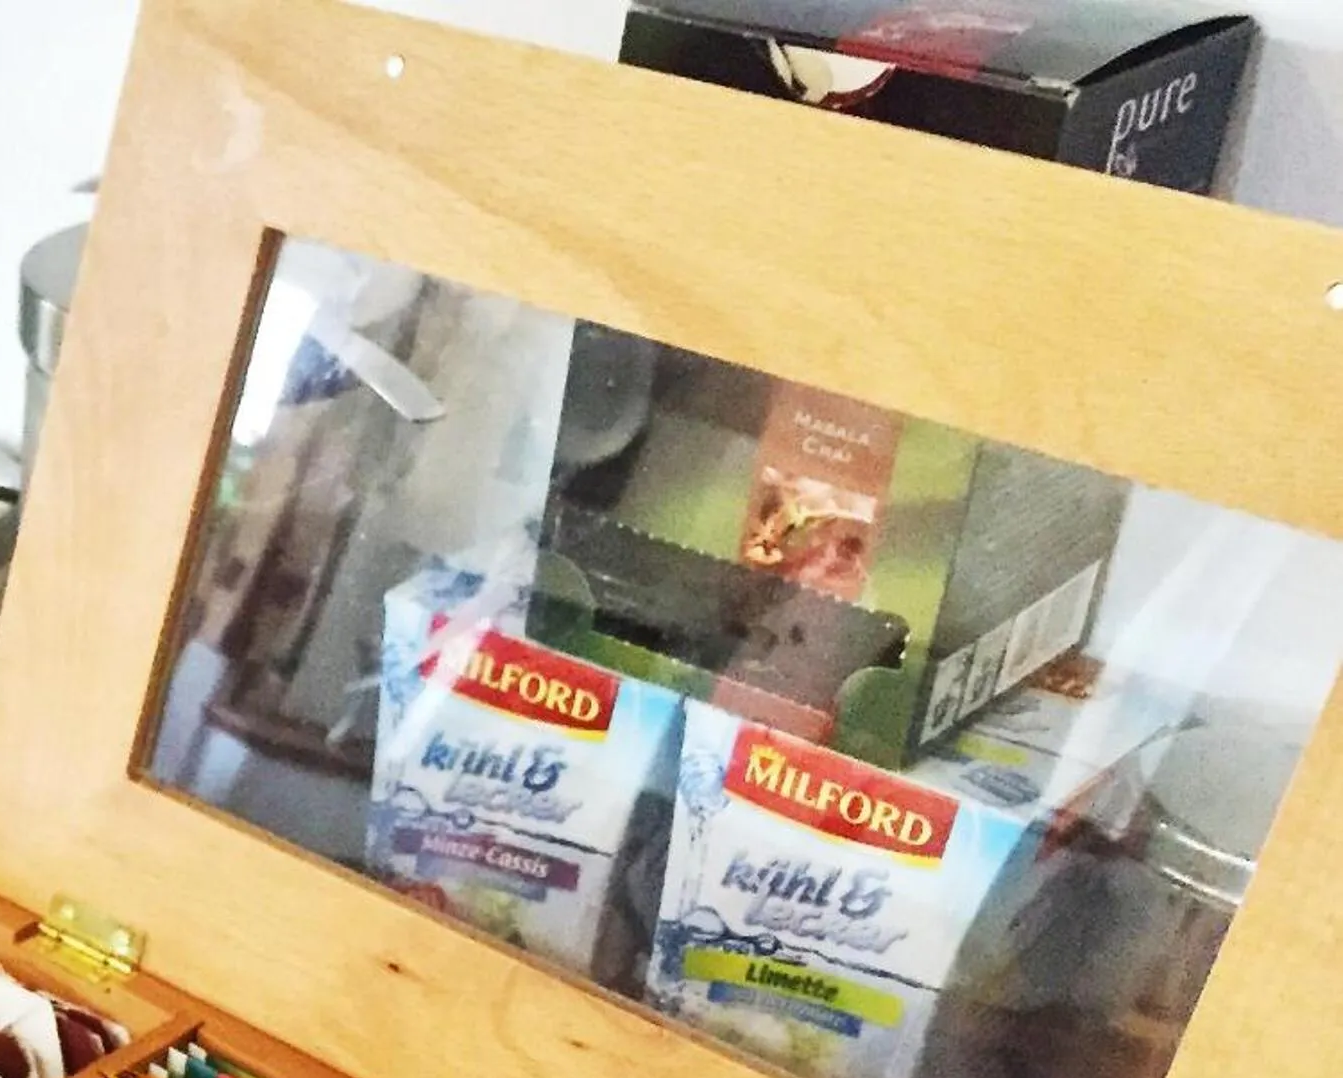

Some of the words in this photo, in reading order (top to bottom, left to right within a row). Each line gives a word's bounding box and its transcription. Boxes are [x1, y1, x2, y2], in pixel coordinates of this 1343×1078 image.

[1106, 72, 1198, 175] pure
[461, 651, 600, 722] ILFORD
[744, 748, 933, 847] MILFORD
[745, 962, 840, 1002] Limette
